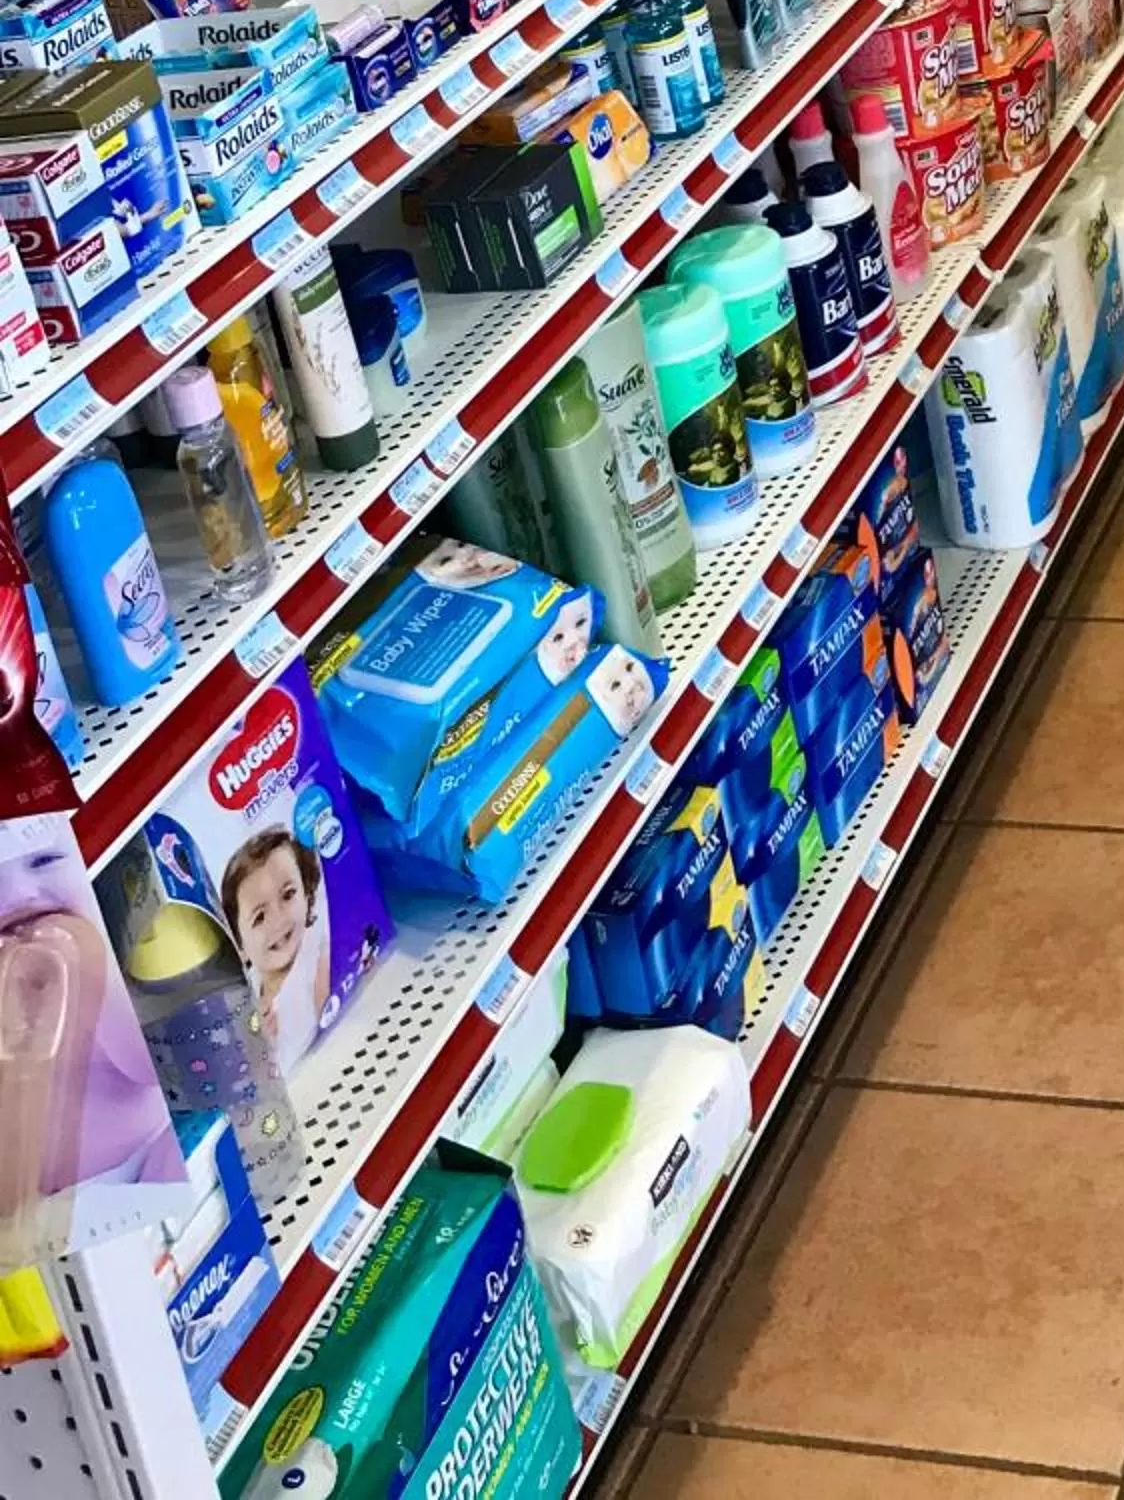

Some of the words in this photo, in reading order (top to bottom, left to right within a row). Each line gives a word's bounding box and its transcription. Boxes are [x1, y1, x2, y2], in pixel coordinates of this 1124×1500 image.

[42, 11, 107, 66] Rolaids
[199, 20, 281, 46] Rolaids
[168, 74, 241, 110] Rolaid
[41, 147, 79, 182] Colgate
[214, 104, 279, 166] Rolaids
[590, 124, 611, 151] Dial
[925, 150, 980, 196] Soup
[63, 236, 104, 272] Colgate
[598, 367, 646, 403] Suave
[878, 495, 911, 544] TAMPAX
[369, 634, 415, 674] Baby
[403, 590, 453, 634] Wipes
[808, 603, 865, 677] TAMPAX
[911, 607, 941, 658] TAMPAX
[737, 689, 781, 751] TAMPAX
[835, 706, 885, 777] TAMPAX
[215, 711, 295, 800] HUGGIES
[242, 759, 301, 819] movers
[766, 789, 808, 854] TAMPAX
[675, 829, 721, 899] TAMPAX
[714, 926, 751, 997] TAMPAX
[653, 1138, 687, 1201] KIRKLAND
[168, 1254, 232, 1333] leenex
[337, 1309, 361, 1337] FOR
[354, 1251, 390, 1311] WOMEN
[384, 1223, 407, 1257] AND
[400, 1197, 425, 1231] MEN
[333, 1378, 368, 1428] LARGE
[425, 1297, 537, 1500] PROTECTIVE
[449, 1326, 542, 1500] DERWEAR
